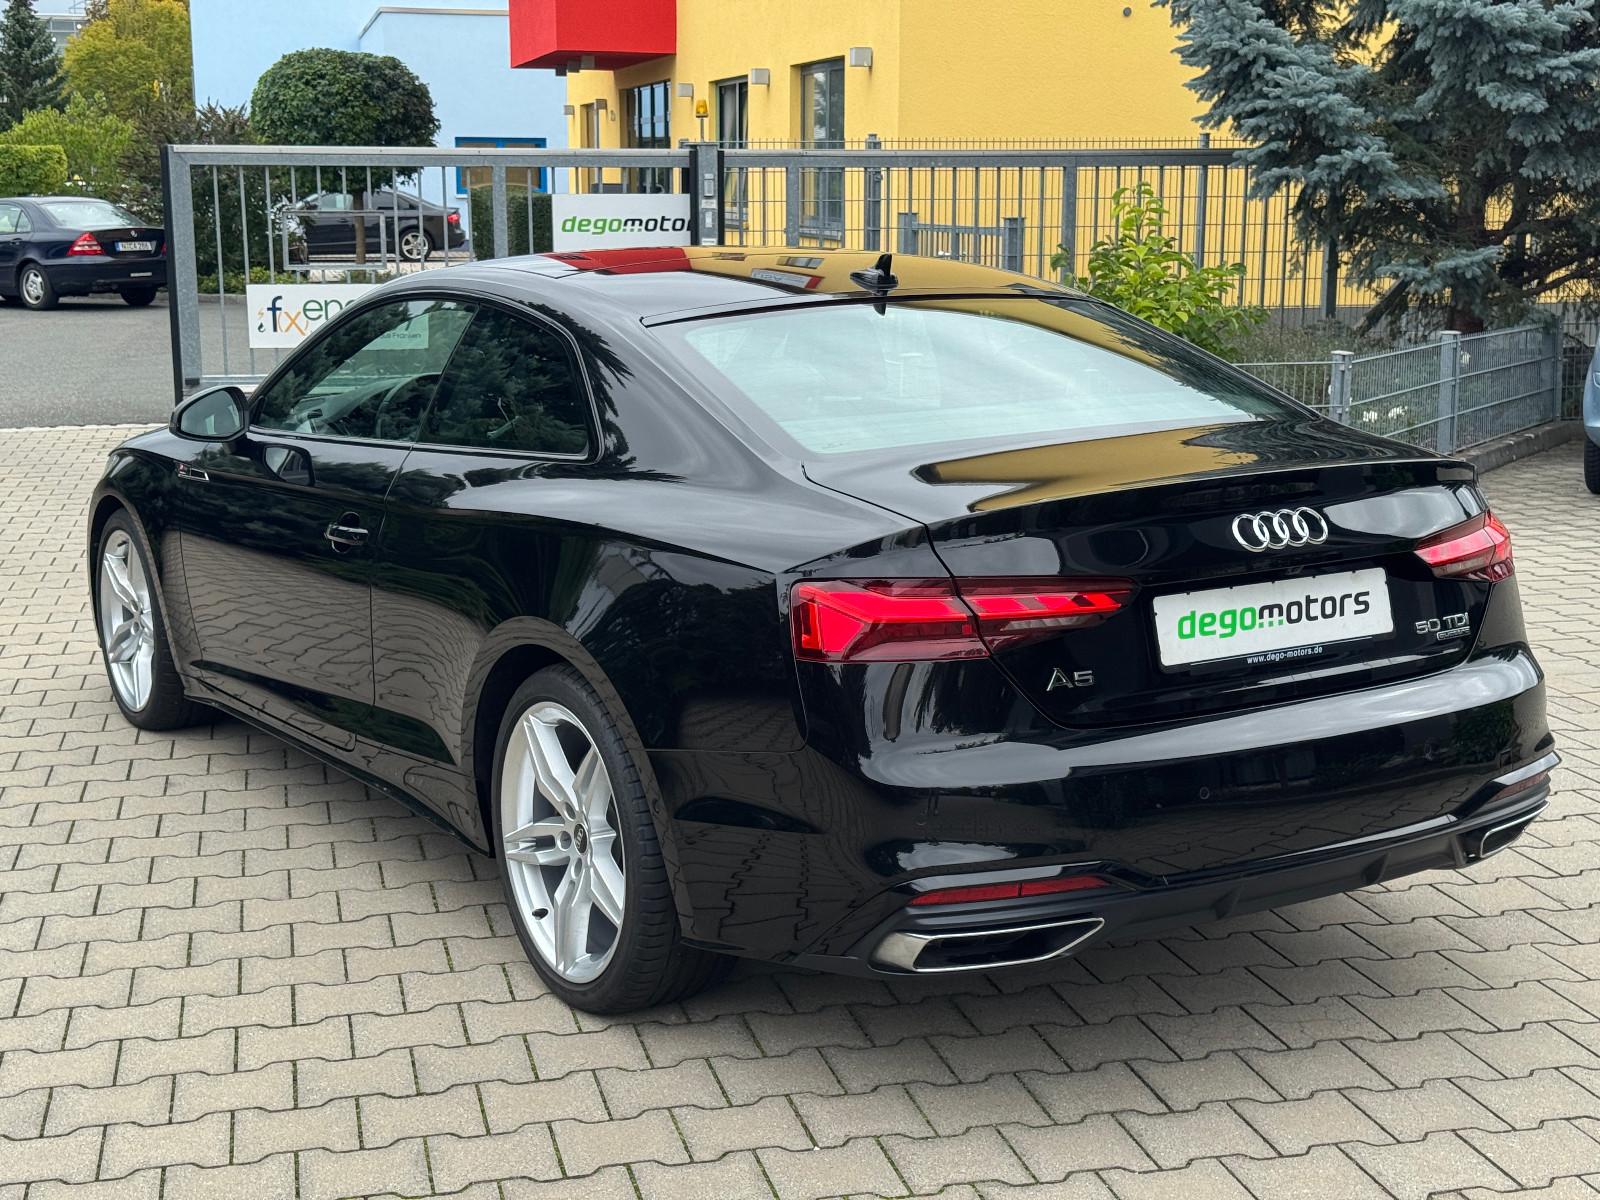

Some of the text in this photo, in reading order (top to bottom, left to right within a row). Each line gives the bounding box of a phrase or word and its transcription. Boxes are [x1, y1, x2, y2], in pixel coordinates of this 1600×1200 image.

[1177, 590, 1371, 640] degomotors
[1415, 619, 1441, 635] 50
[1443, 612, 1469, 629] TDI
[1246, 645, 1323, 664] www.dego-motors.de
[1046, 667, 1094, 691] A5
